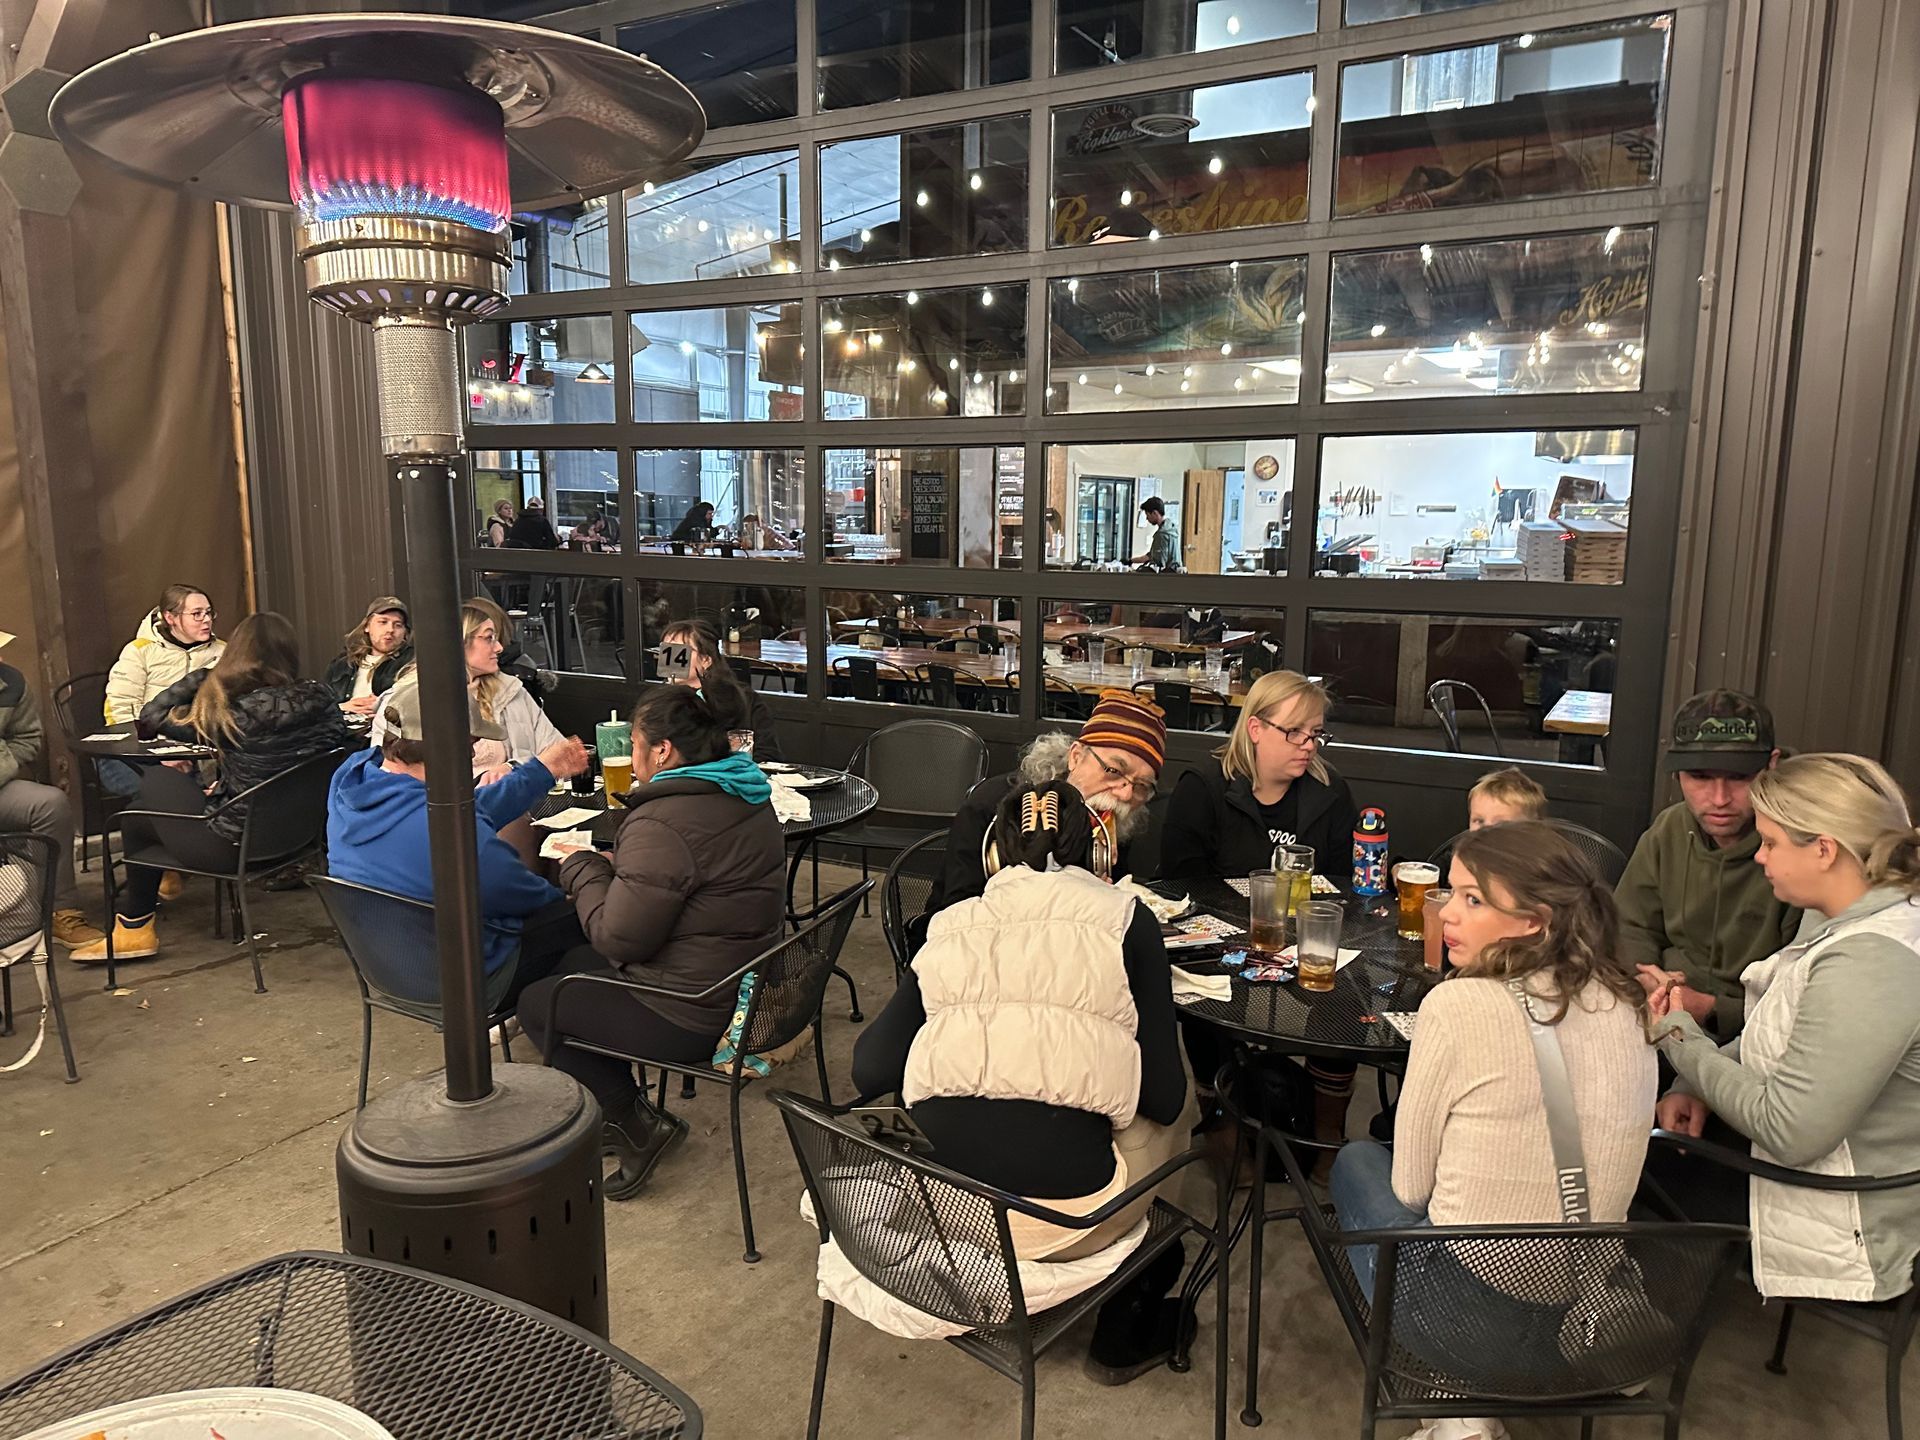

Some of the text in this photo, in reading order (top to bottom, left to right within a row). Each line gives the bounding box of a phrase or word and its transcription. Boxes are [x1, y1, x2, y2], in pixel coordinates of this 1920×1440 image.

[1052, 180, 1307, 246] Reeshing
[662, 646, 688, 668] 14
[860, 1113, 917, 1139] 24
